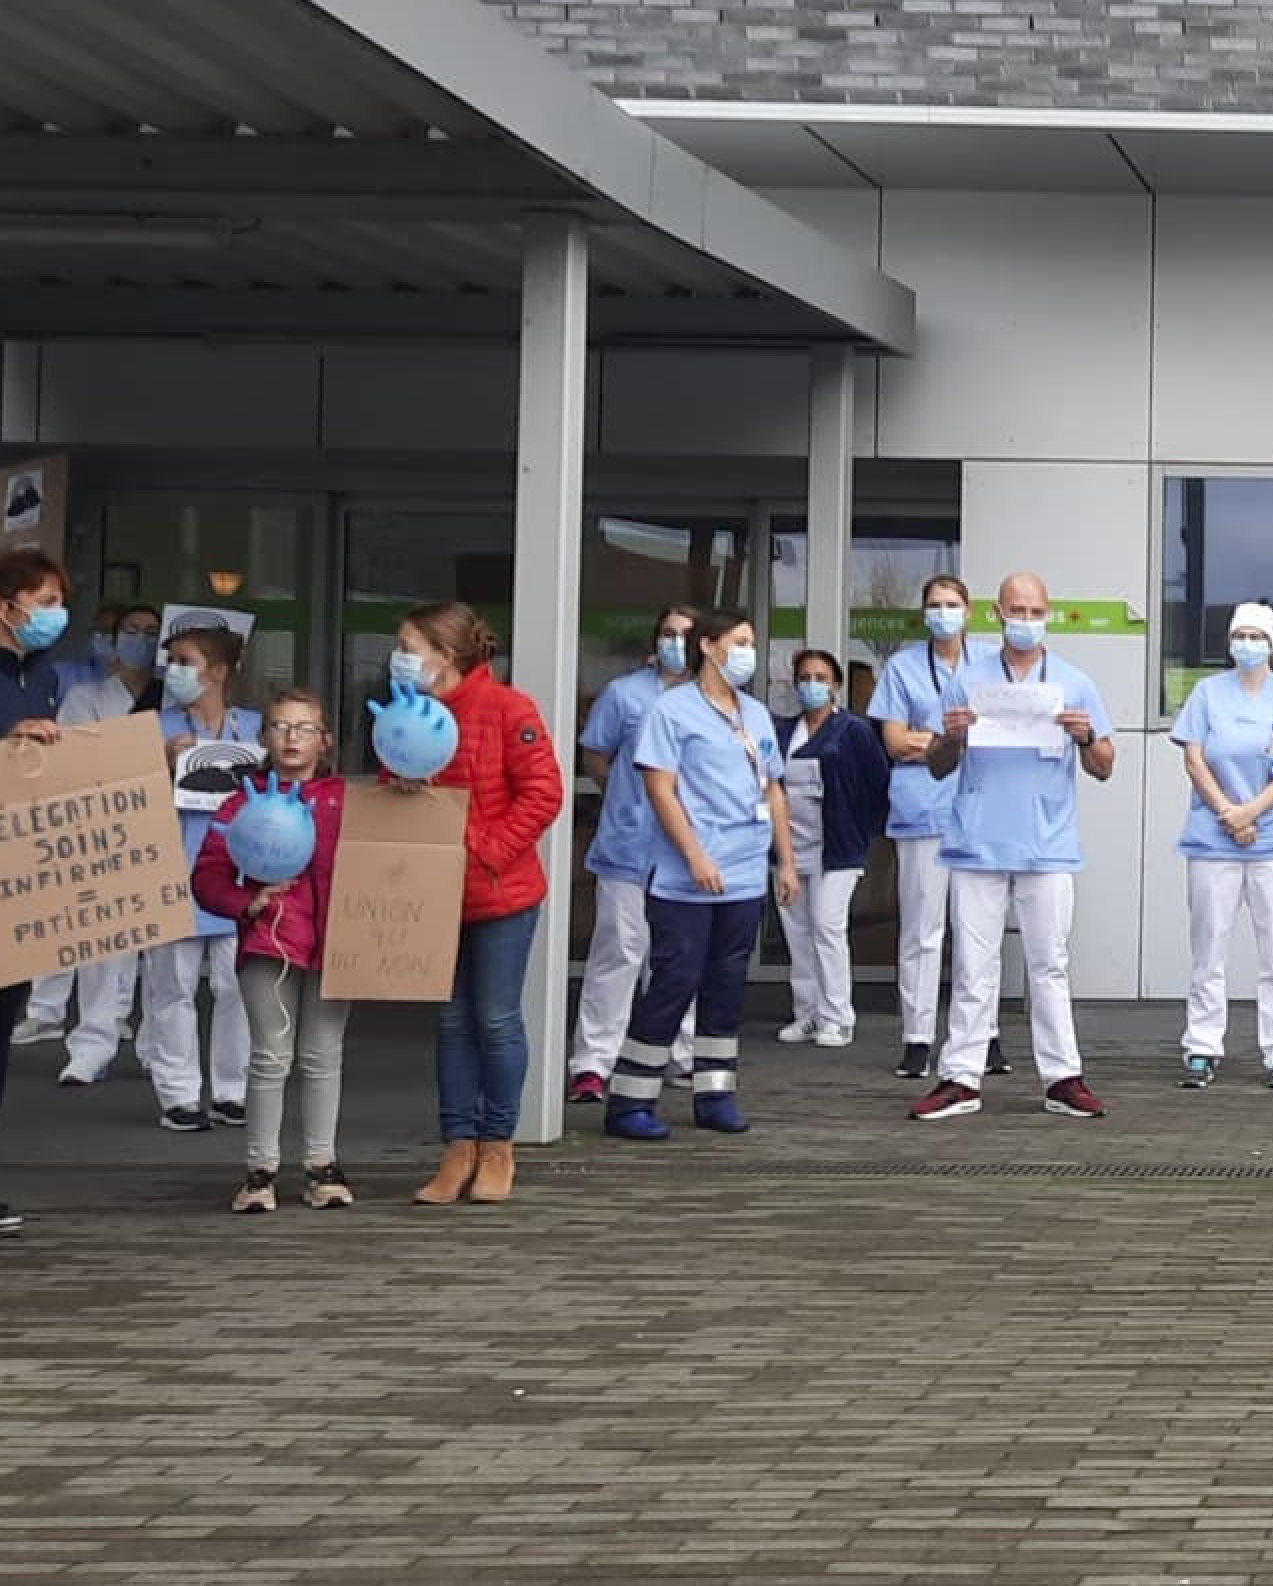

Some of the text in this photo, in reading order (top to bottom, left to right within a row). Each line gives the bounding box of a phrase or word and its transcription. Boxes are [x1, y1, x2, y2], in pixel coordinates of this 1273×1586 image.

[34, 823, 127, 864] SOINS
[14, 882, 189, 943] PATIENTS EN
[58, 924, 161, 967] DANGER
